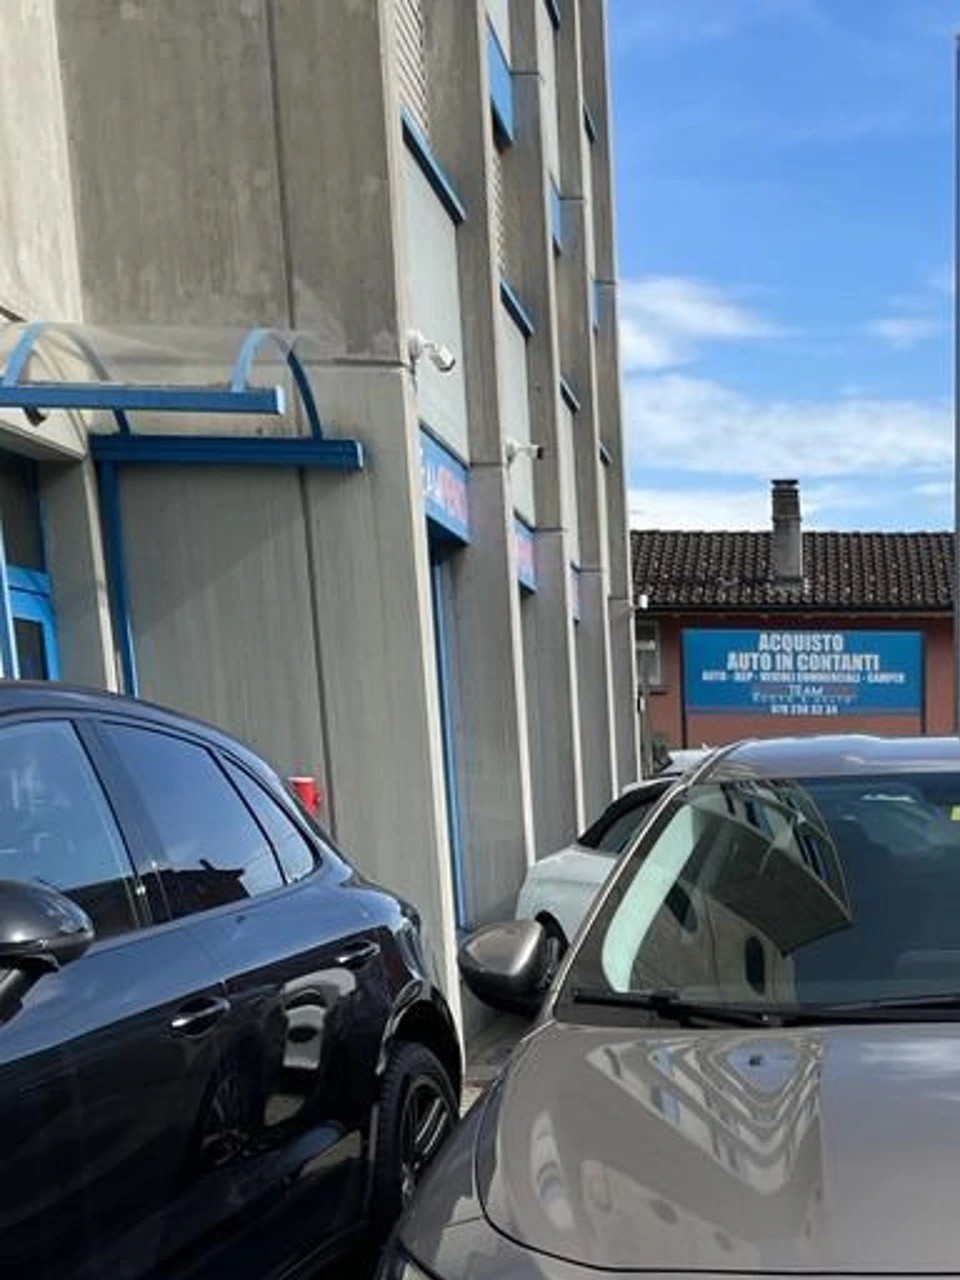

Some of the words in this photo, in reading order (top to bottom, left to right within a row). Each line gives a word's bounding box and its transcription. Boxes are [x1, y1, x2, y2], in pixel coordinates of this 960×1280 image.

[759, 633, 844, 652] ACQUISTO
[727, 652, 771, 671] AUTO
[775, 652, 794, 671] IN
[797, 653, 880, 671] CONTANTI
